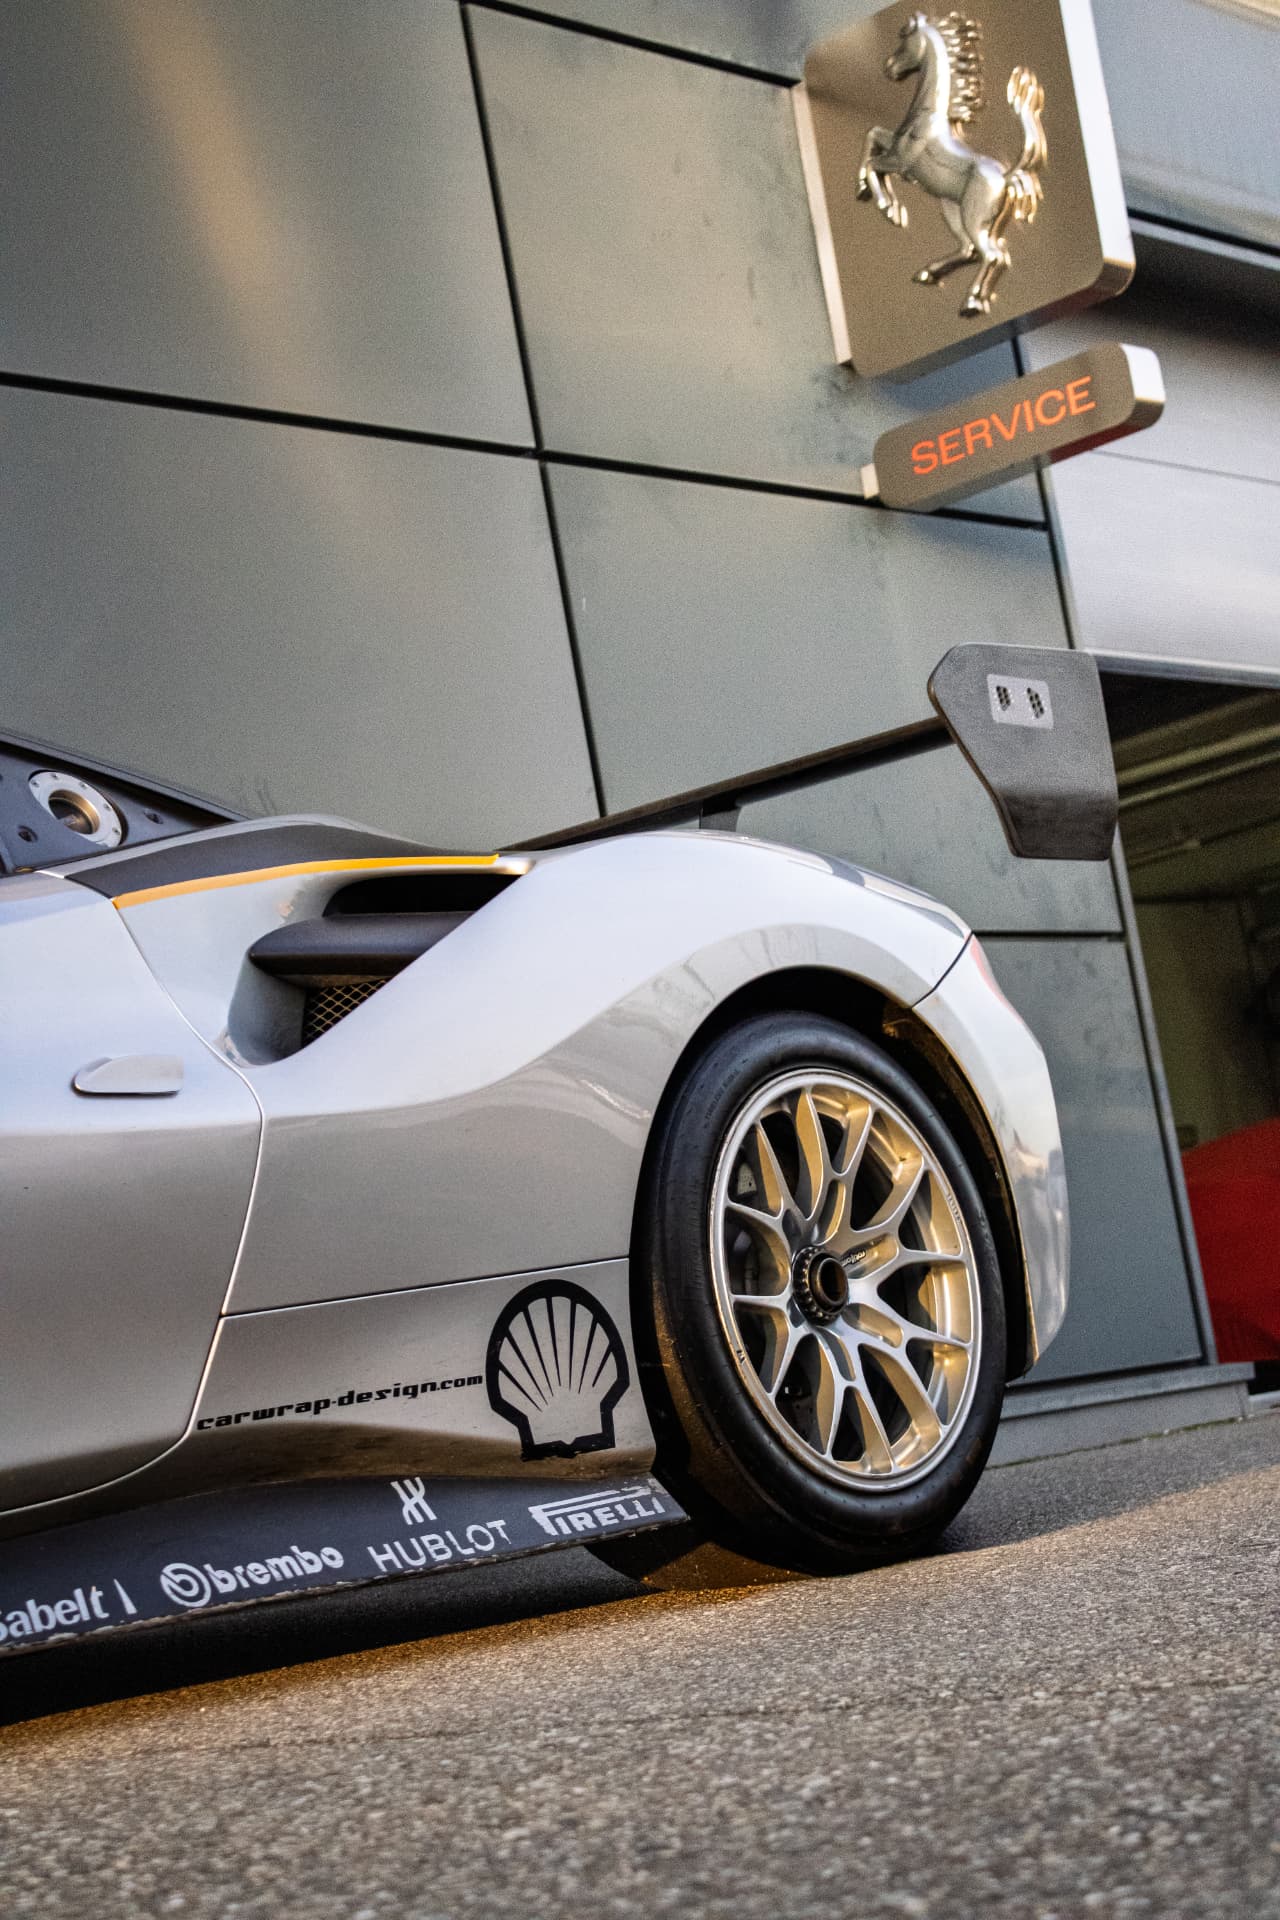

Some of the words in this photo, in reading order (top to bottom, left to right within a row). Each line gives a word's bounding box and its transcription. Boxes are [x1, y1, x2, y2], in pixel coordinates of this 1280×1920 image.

[911, 375, 1096, 475] SERVICE
[197, 1375, 483, 1430] carwrap-design.com
[528, 1486, 666, 1536] PIRELLI
[203, 1545, 345, 1593] brembo
[367, 1519, 512, 1572] HUBLOT
